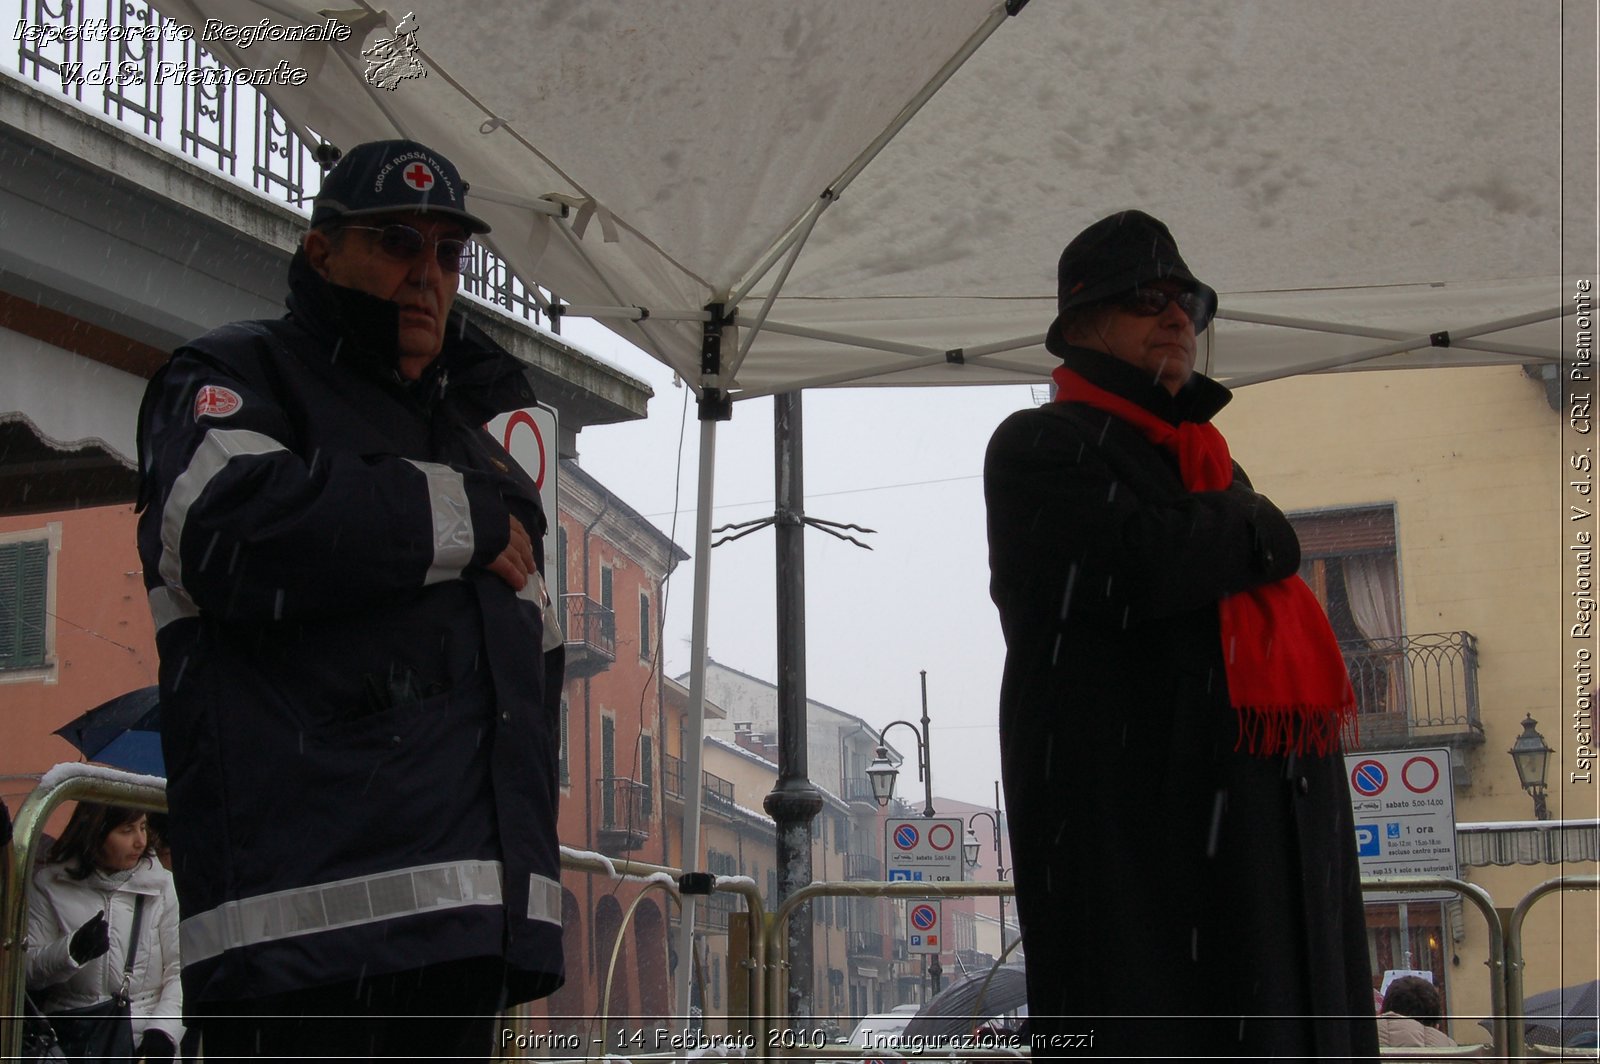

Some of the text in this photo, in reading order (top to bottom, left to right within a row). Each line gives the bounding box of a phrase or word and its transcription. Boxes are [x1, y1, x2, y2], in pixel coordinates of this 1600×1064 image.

[375, 151, 456, 201] CROCE ROSSA ITALIANA
[1355, 829, 1373, 853] P
[1406, 826, 1434, 834] 1 ora
